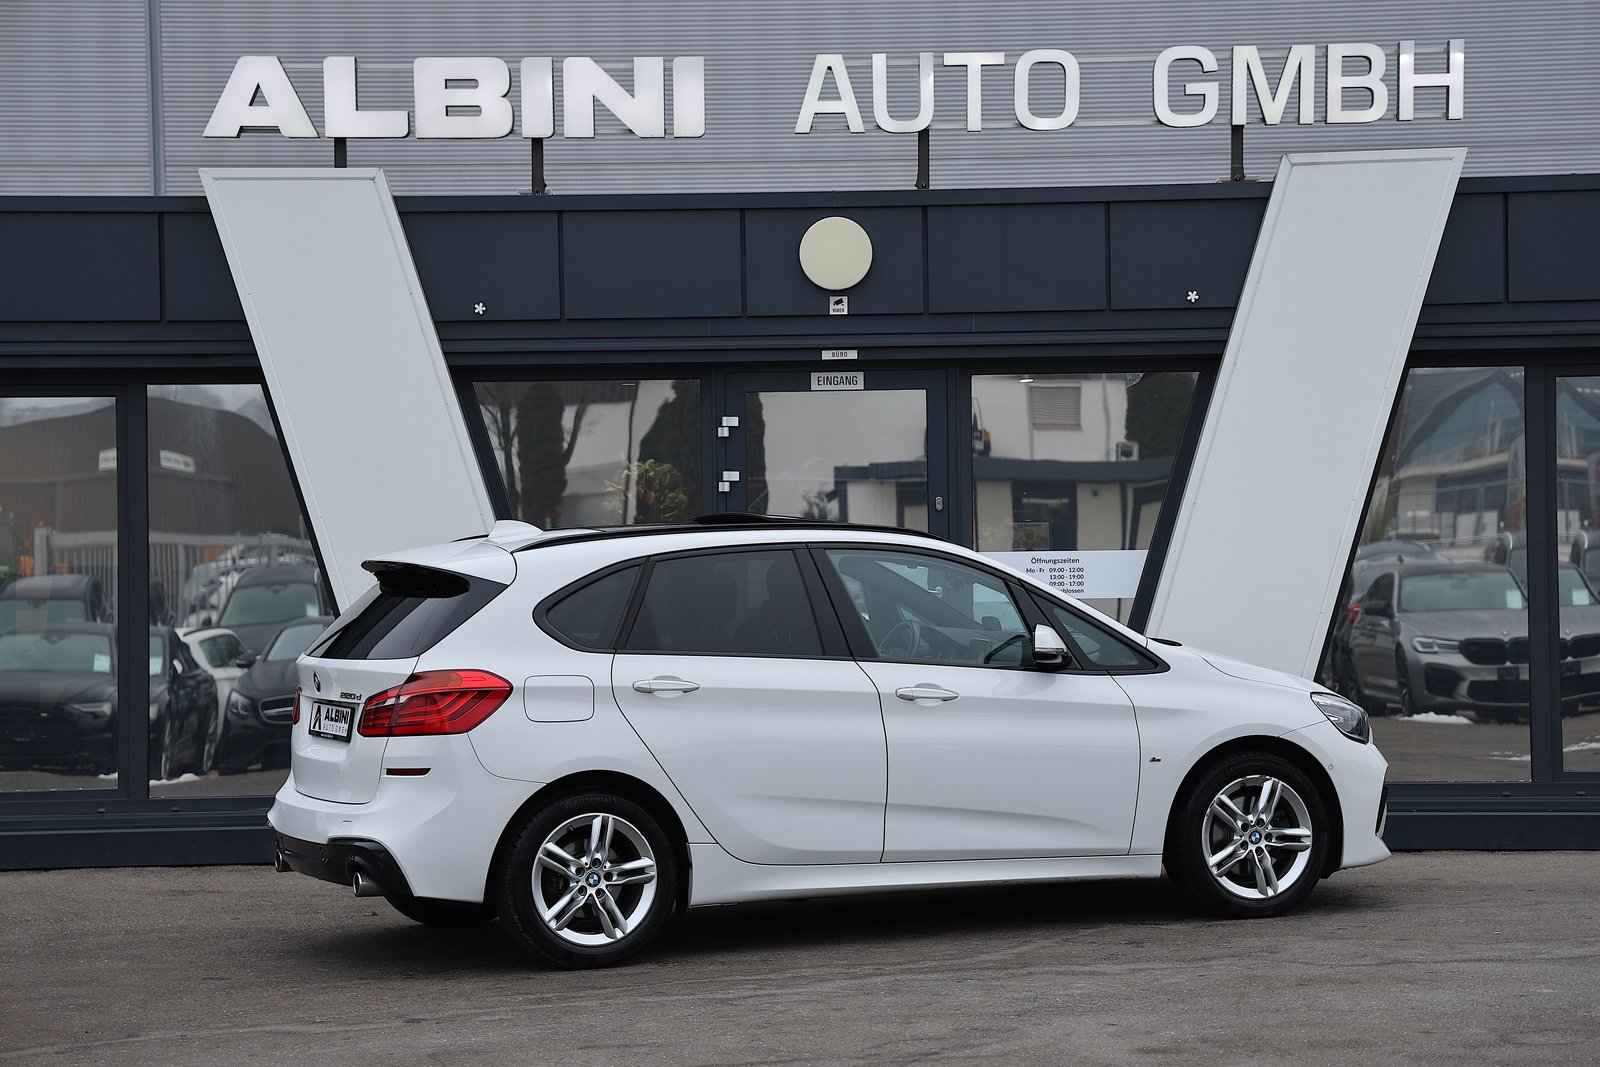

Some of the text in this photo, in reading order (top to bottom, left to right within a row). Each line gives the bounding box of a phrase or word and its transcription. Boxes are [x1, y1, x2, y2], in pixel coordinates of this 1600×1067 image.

[202, 39, 1465, 138] ALBINI AUTO GMBH
[817, 375, 858, 386] EINGANG
[1030, 557, 1080, 565] Öffnungszeiten
[324, 707, 350, 725] ALBINI
